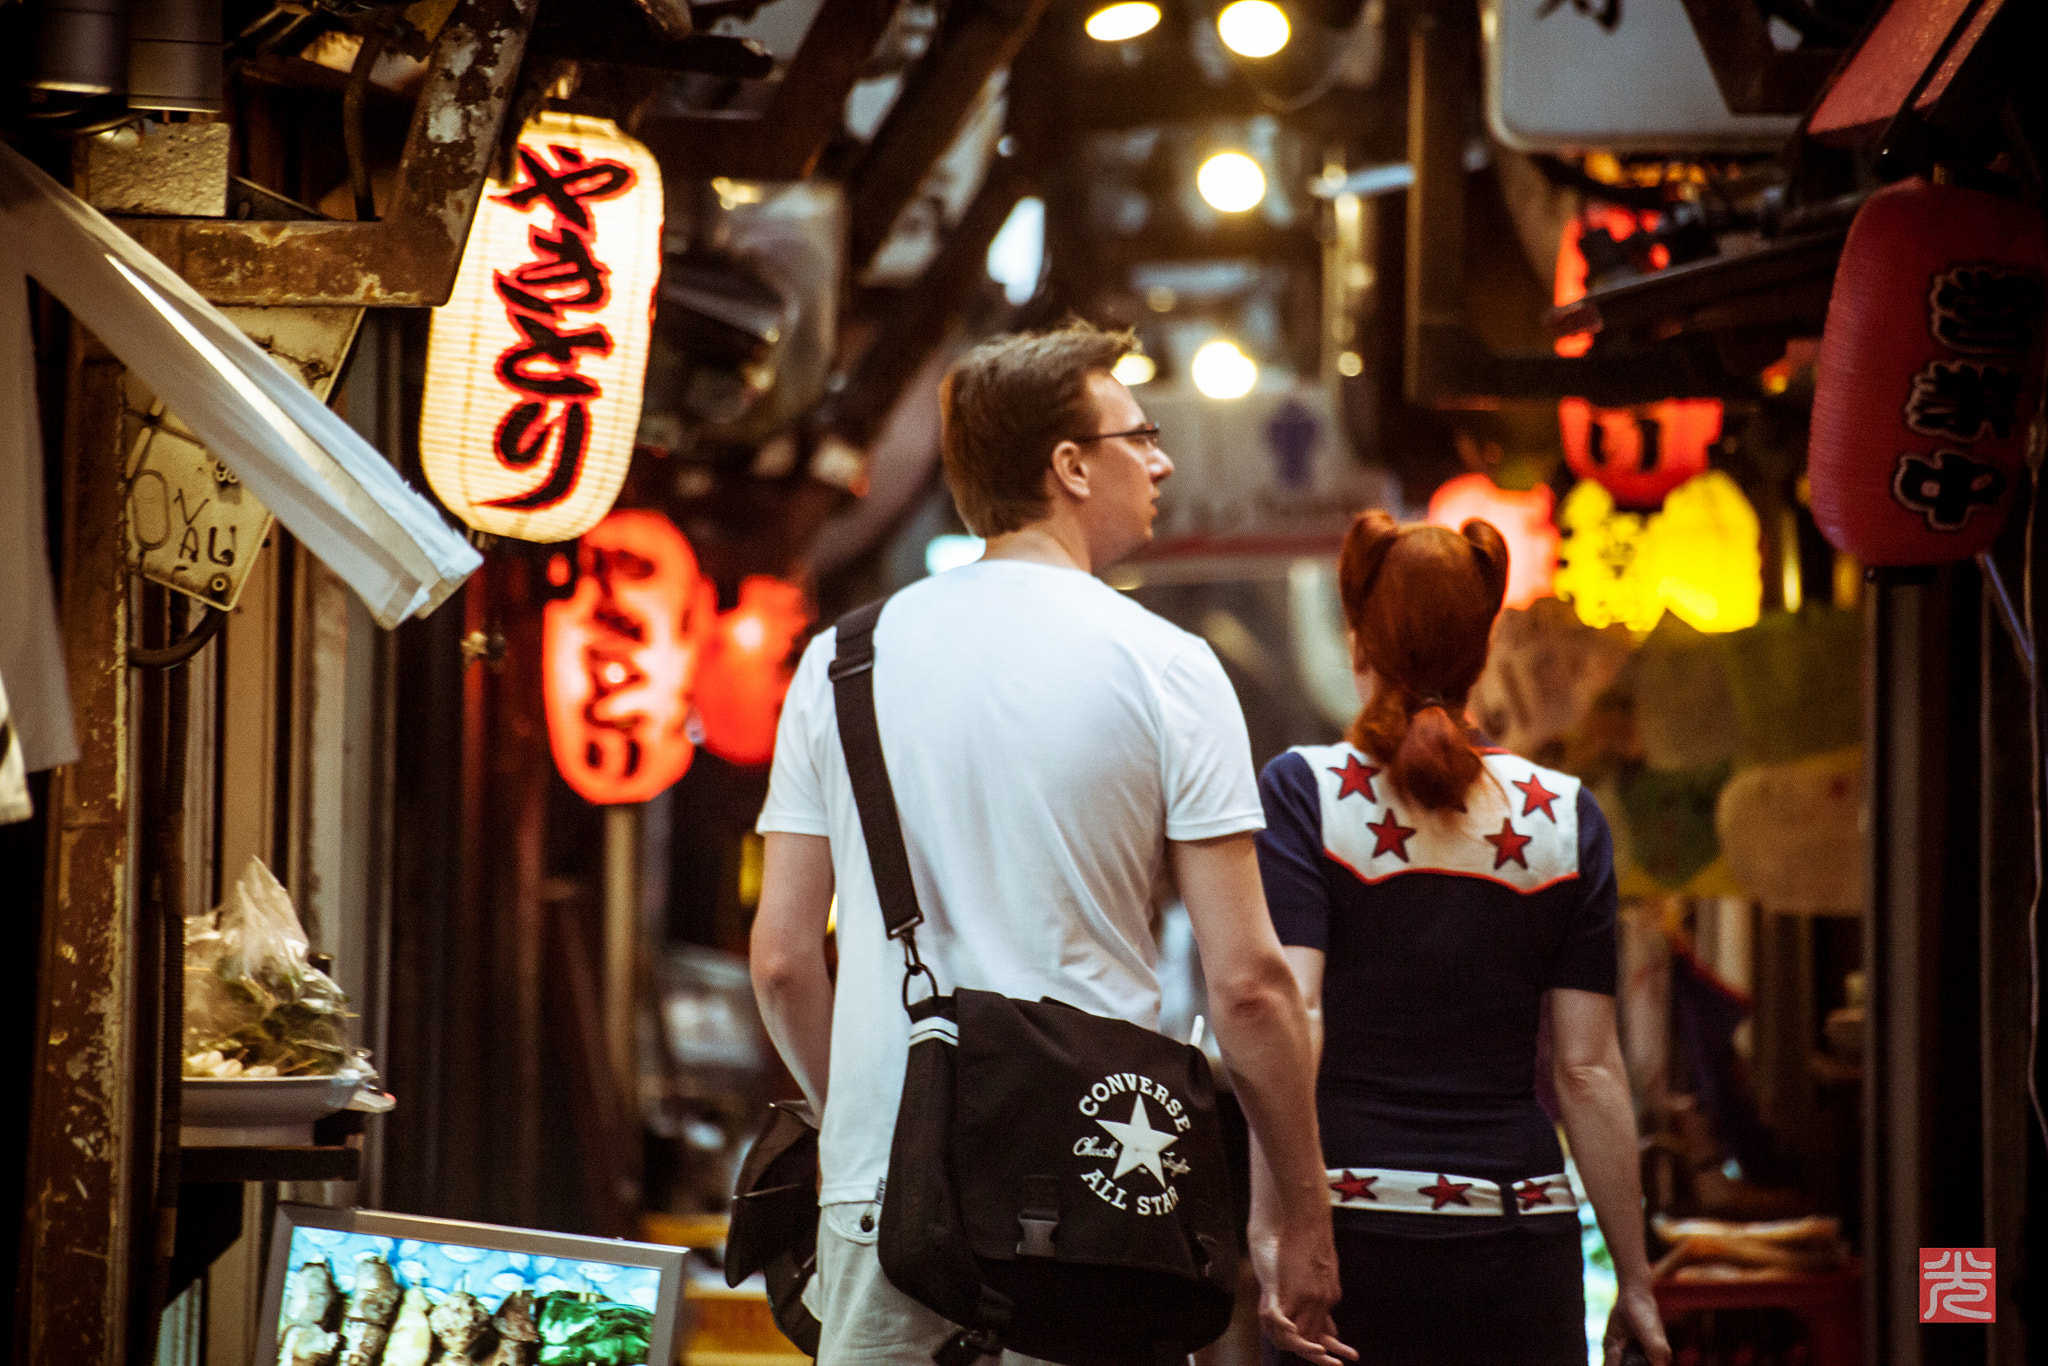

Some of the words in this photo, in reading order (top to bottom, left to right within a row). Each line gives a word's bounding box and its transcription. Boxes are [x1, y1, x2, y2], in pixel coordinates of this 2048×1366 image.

[470, 144, 638, 511] やきとり
[1078, 1072, 1191, 1132] CONVERSE
[1080, 1168, 1128, 1211] ALL
[1136, 1185, 1179, 1216] STAR
